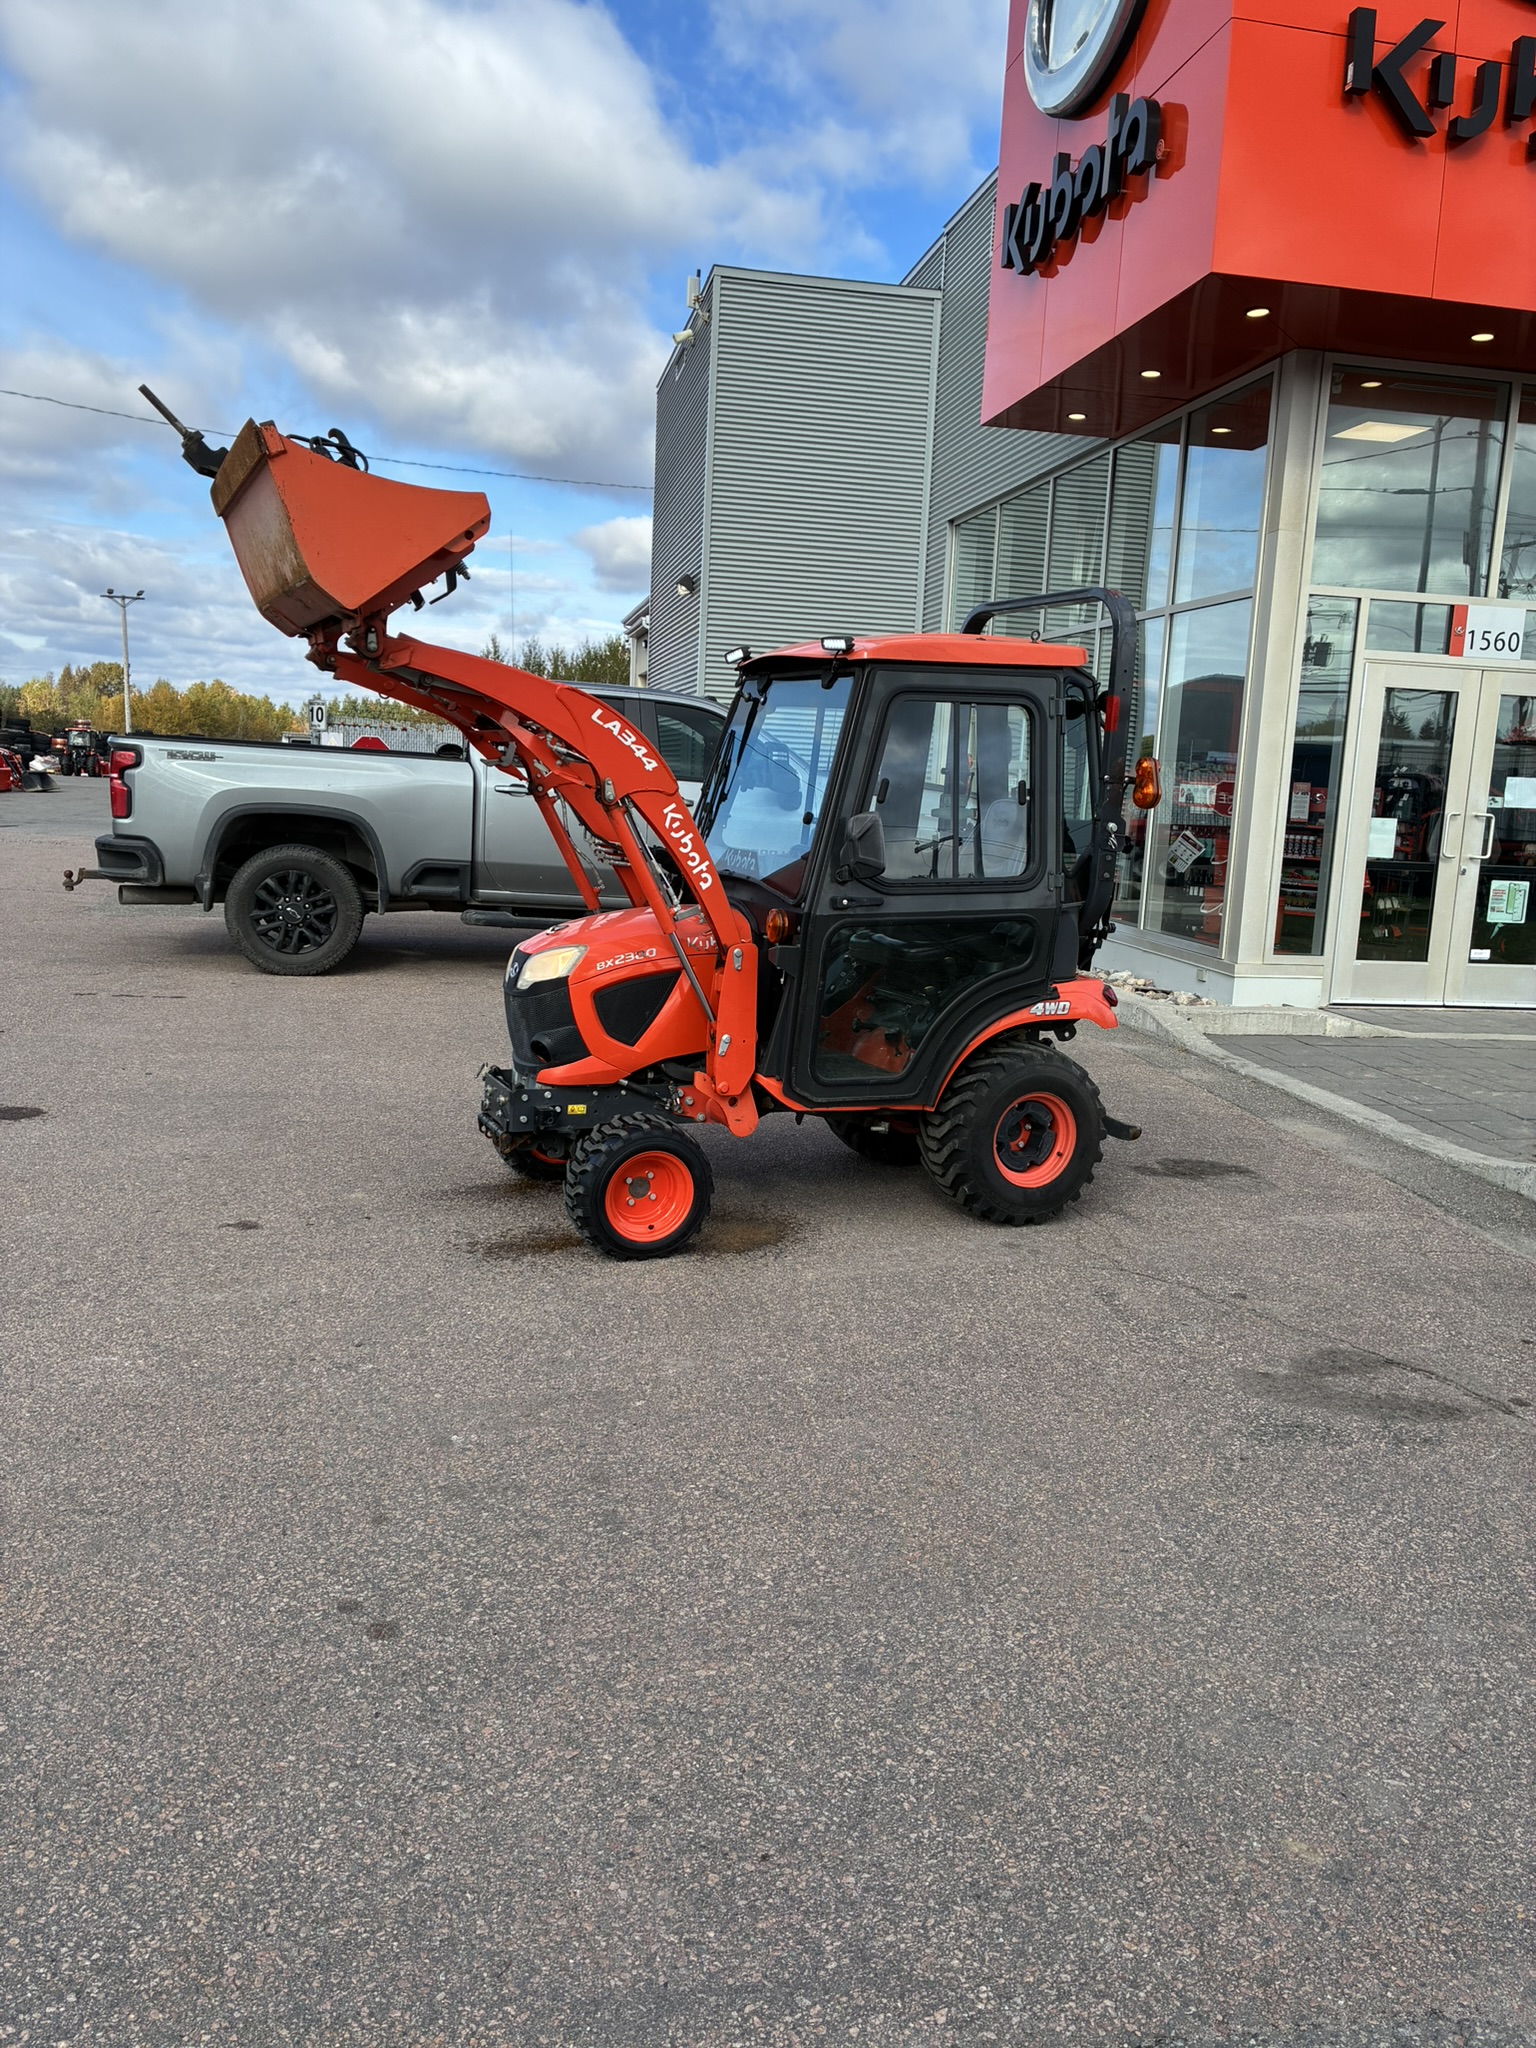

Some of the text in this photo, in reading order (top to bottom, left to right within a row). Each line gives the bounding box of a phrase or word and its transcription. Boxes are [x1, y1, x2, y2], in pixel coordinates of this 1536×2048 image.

[1001, 93, 1162, 276] Kubota
[1468, 630, 1520, 652] 1560
[309, 706, 324, 723] 10
[591, 708, 658, 772] LA344
[662, 802, 713, 890] Kubota
[1029, 1001, 1071, 1016] 4WD
